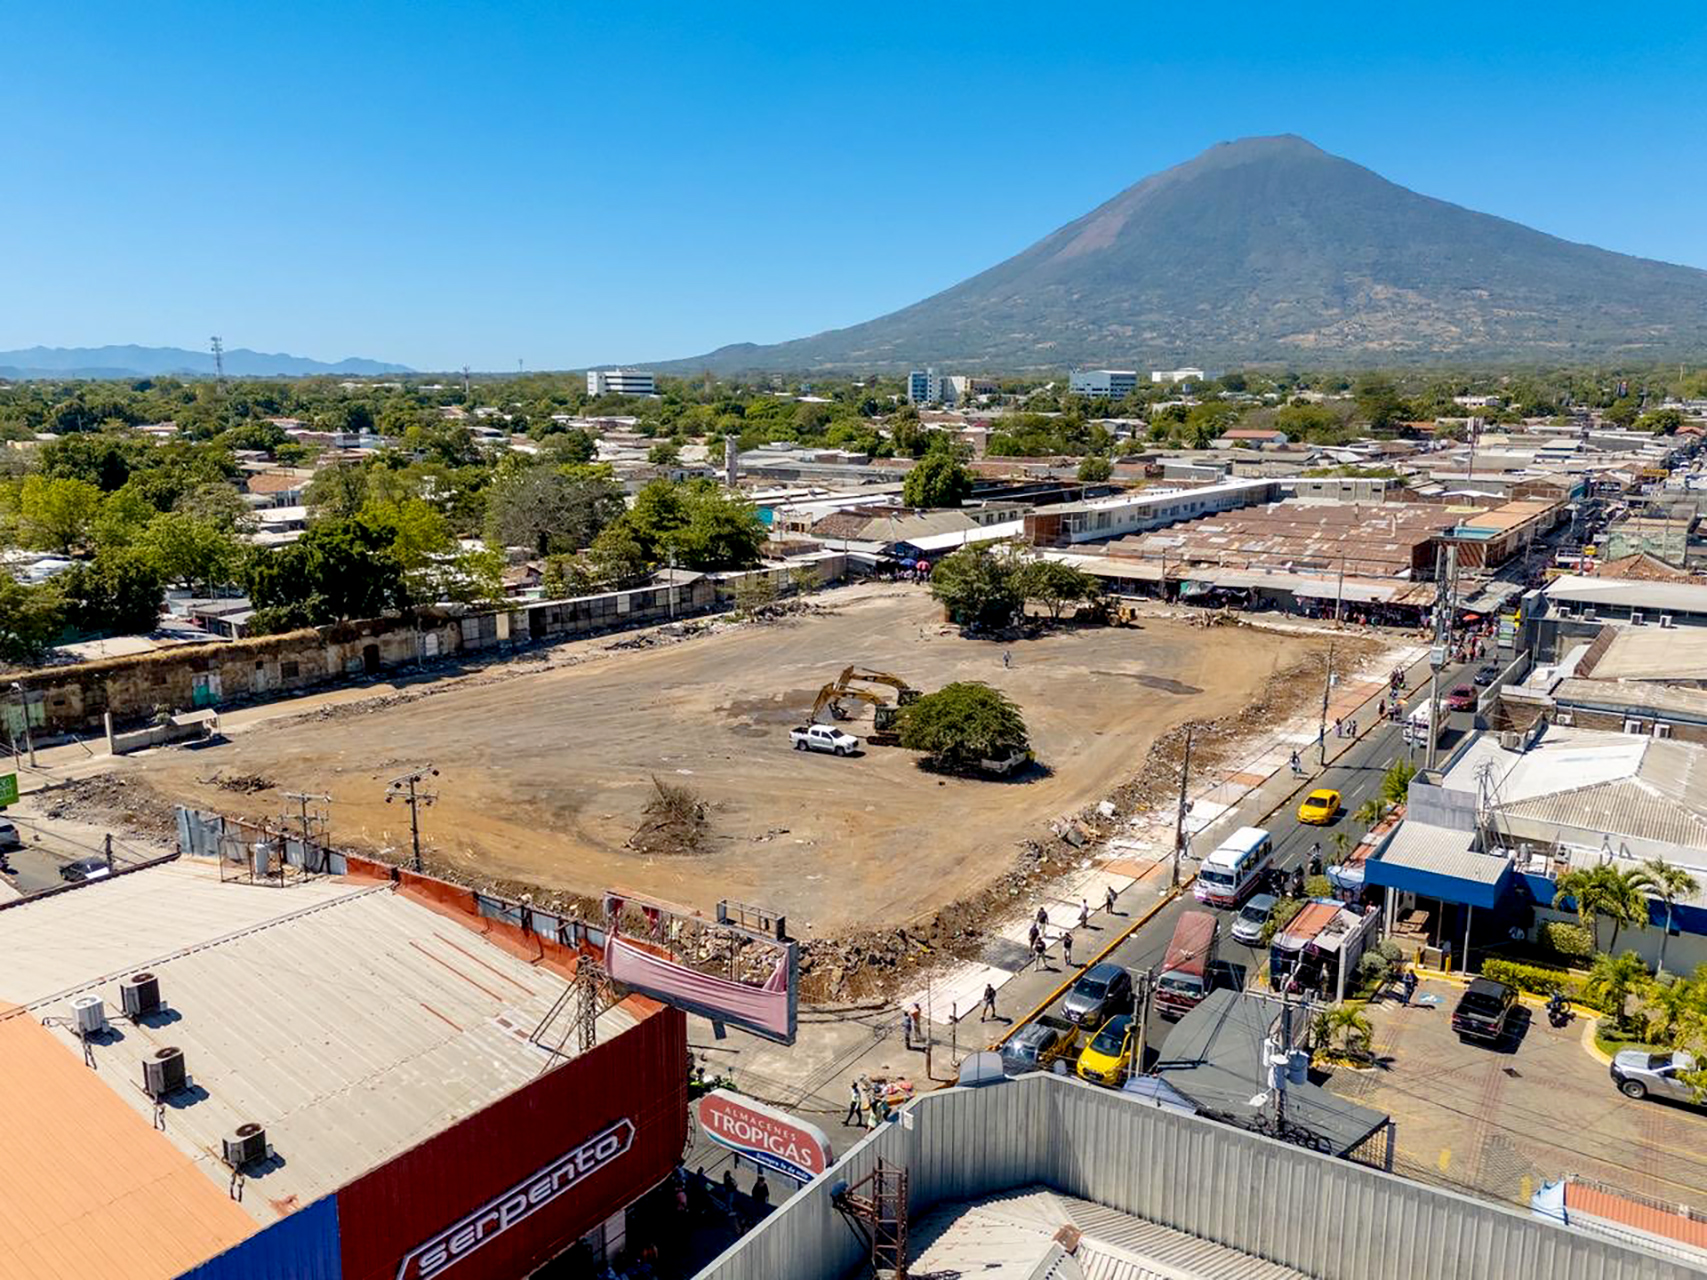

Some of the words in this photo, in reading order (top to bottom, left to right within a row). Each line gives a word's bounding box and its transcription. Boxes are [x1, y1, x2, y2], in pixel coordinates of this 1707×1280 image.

[709, 1108, 812, 1167] TROPIGAS
[725, 1107, 797, 1141] ALMACENES
[418, 1134, 620, 1276] serpento
